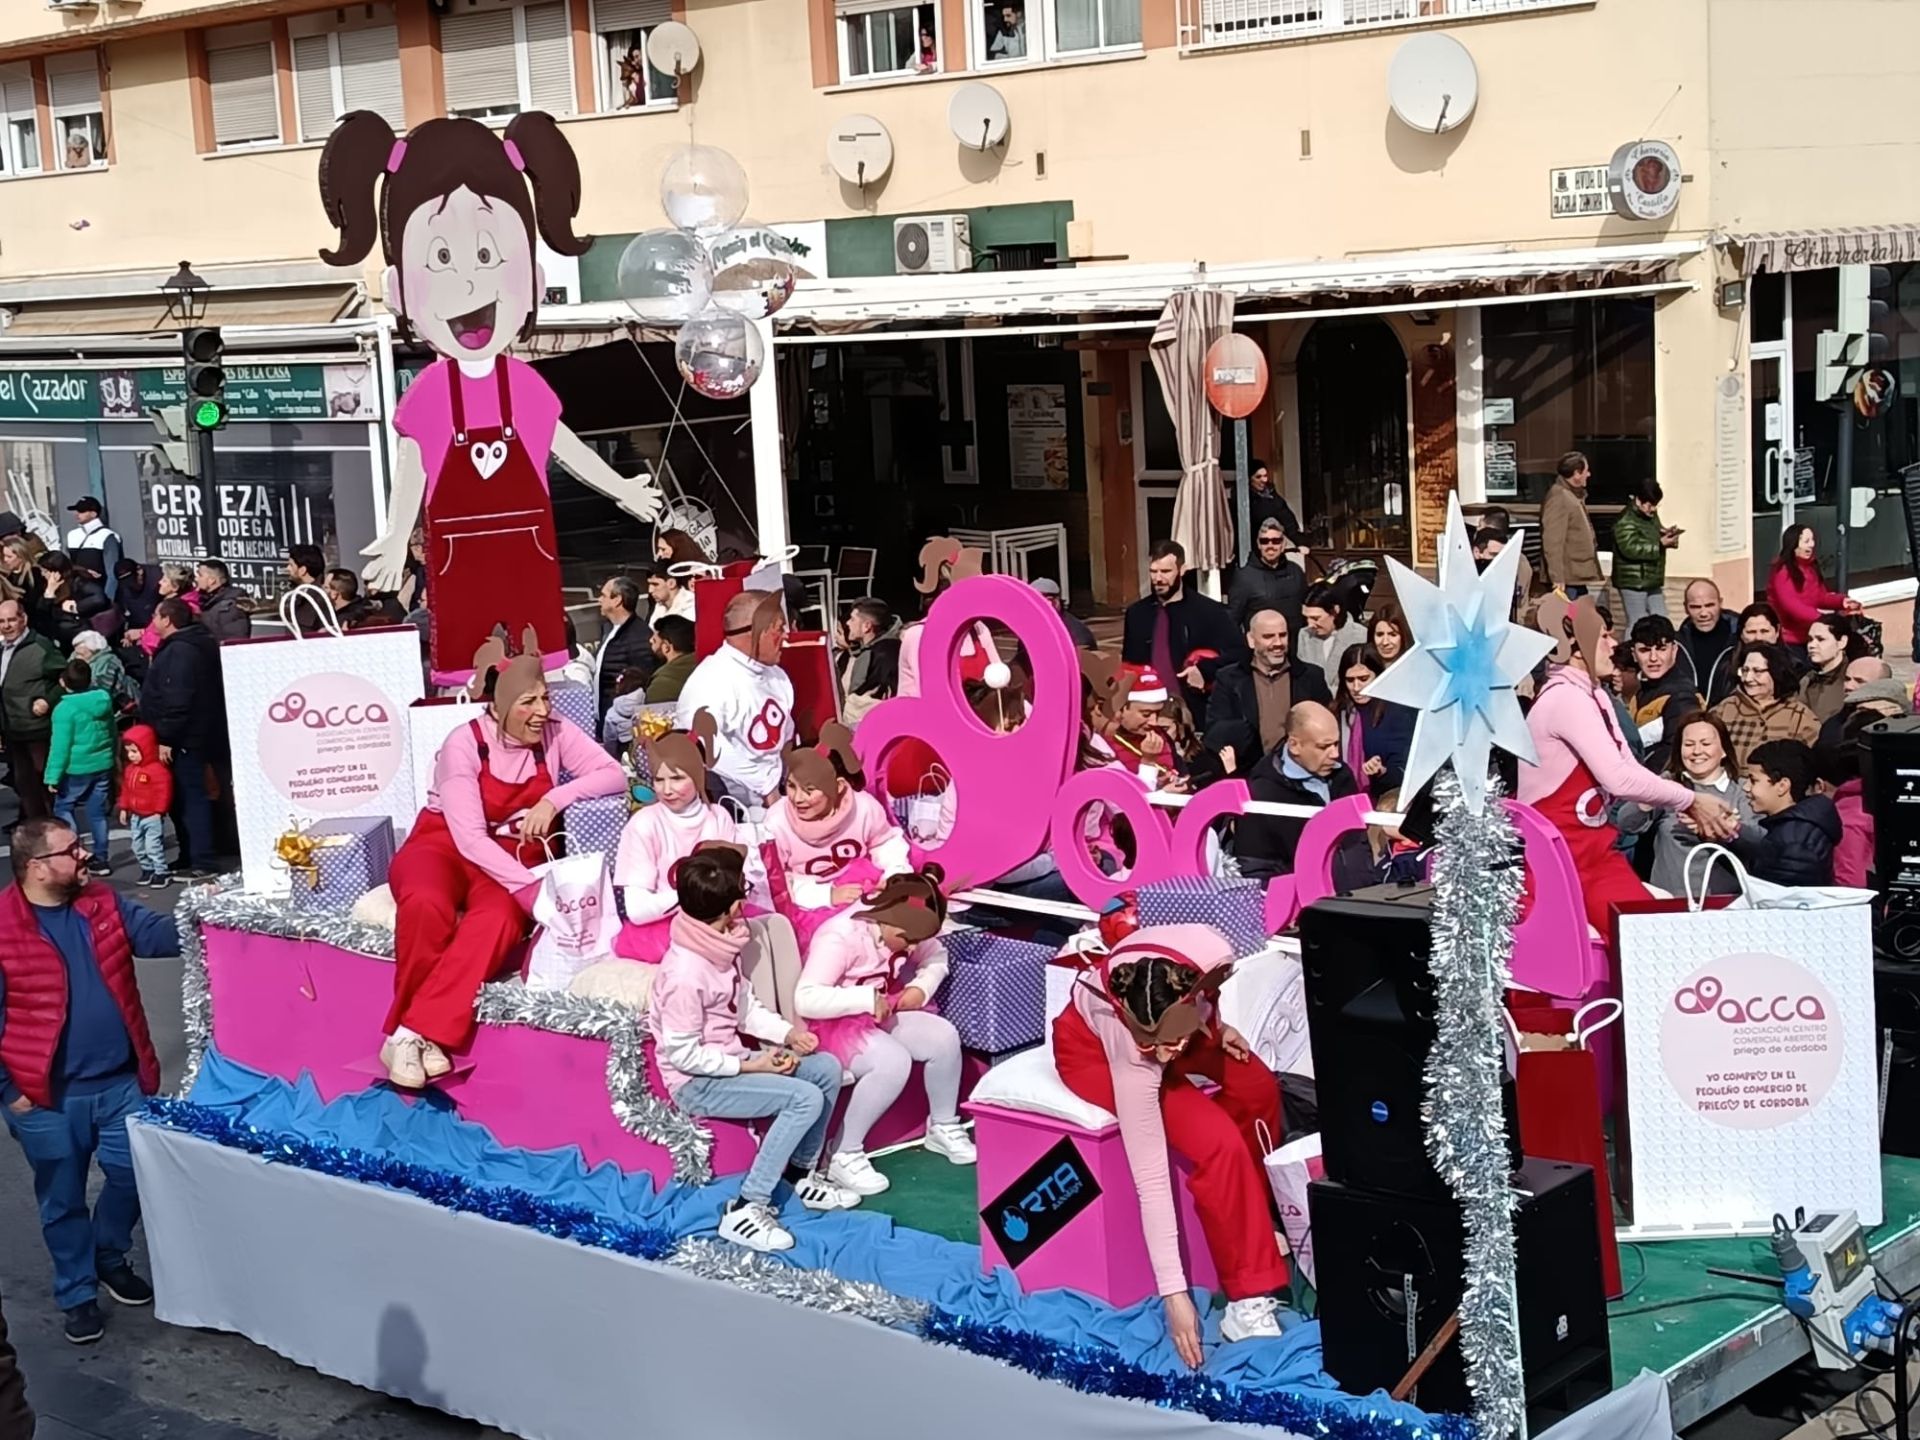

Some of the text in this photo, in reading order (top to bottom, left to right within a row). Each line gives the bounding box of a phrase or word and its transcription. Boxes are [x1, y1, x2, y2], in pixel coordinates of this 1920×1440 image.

[0, 372, 89, 415] el Cazador
[151, 483, 273, 517] CEREZA
[217, 518, 275, 538] ODEGA
[220, 537, 246, 558] CIÉN
[240, 563, 256, 579] LA
[1716, 995, 1826, 1024] acca
[1792, 1023, 1828, 1034] CENTRO
[1733, 1033, 1827, 1045] COMERCIAL ABIERTO DE
[1733, 1046, 1766, 1056] priego
[1768, 1045, 1782, 1054] de
[1706, 1073, 1720, 1082] YO
[1770, 1071, 1783, 1080] EN
[1786, 1070, 1796, 1080] EL
[1696, 1083, 1807, 1097] PEQUEÑO COMERCIO DE
[1743, 1099, 1756, 1109] DE
